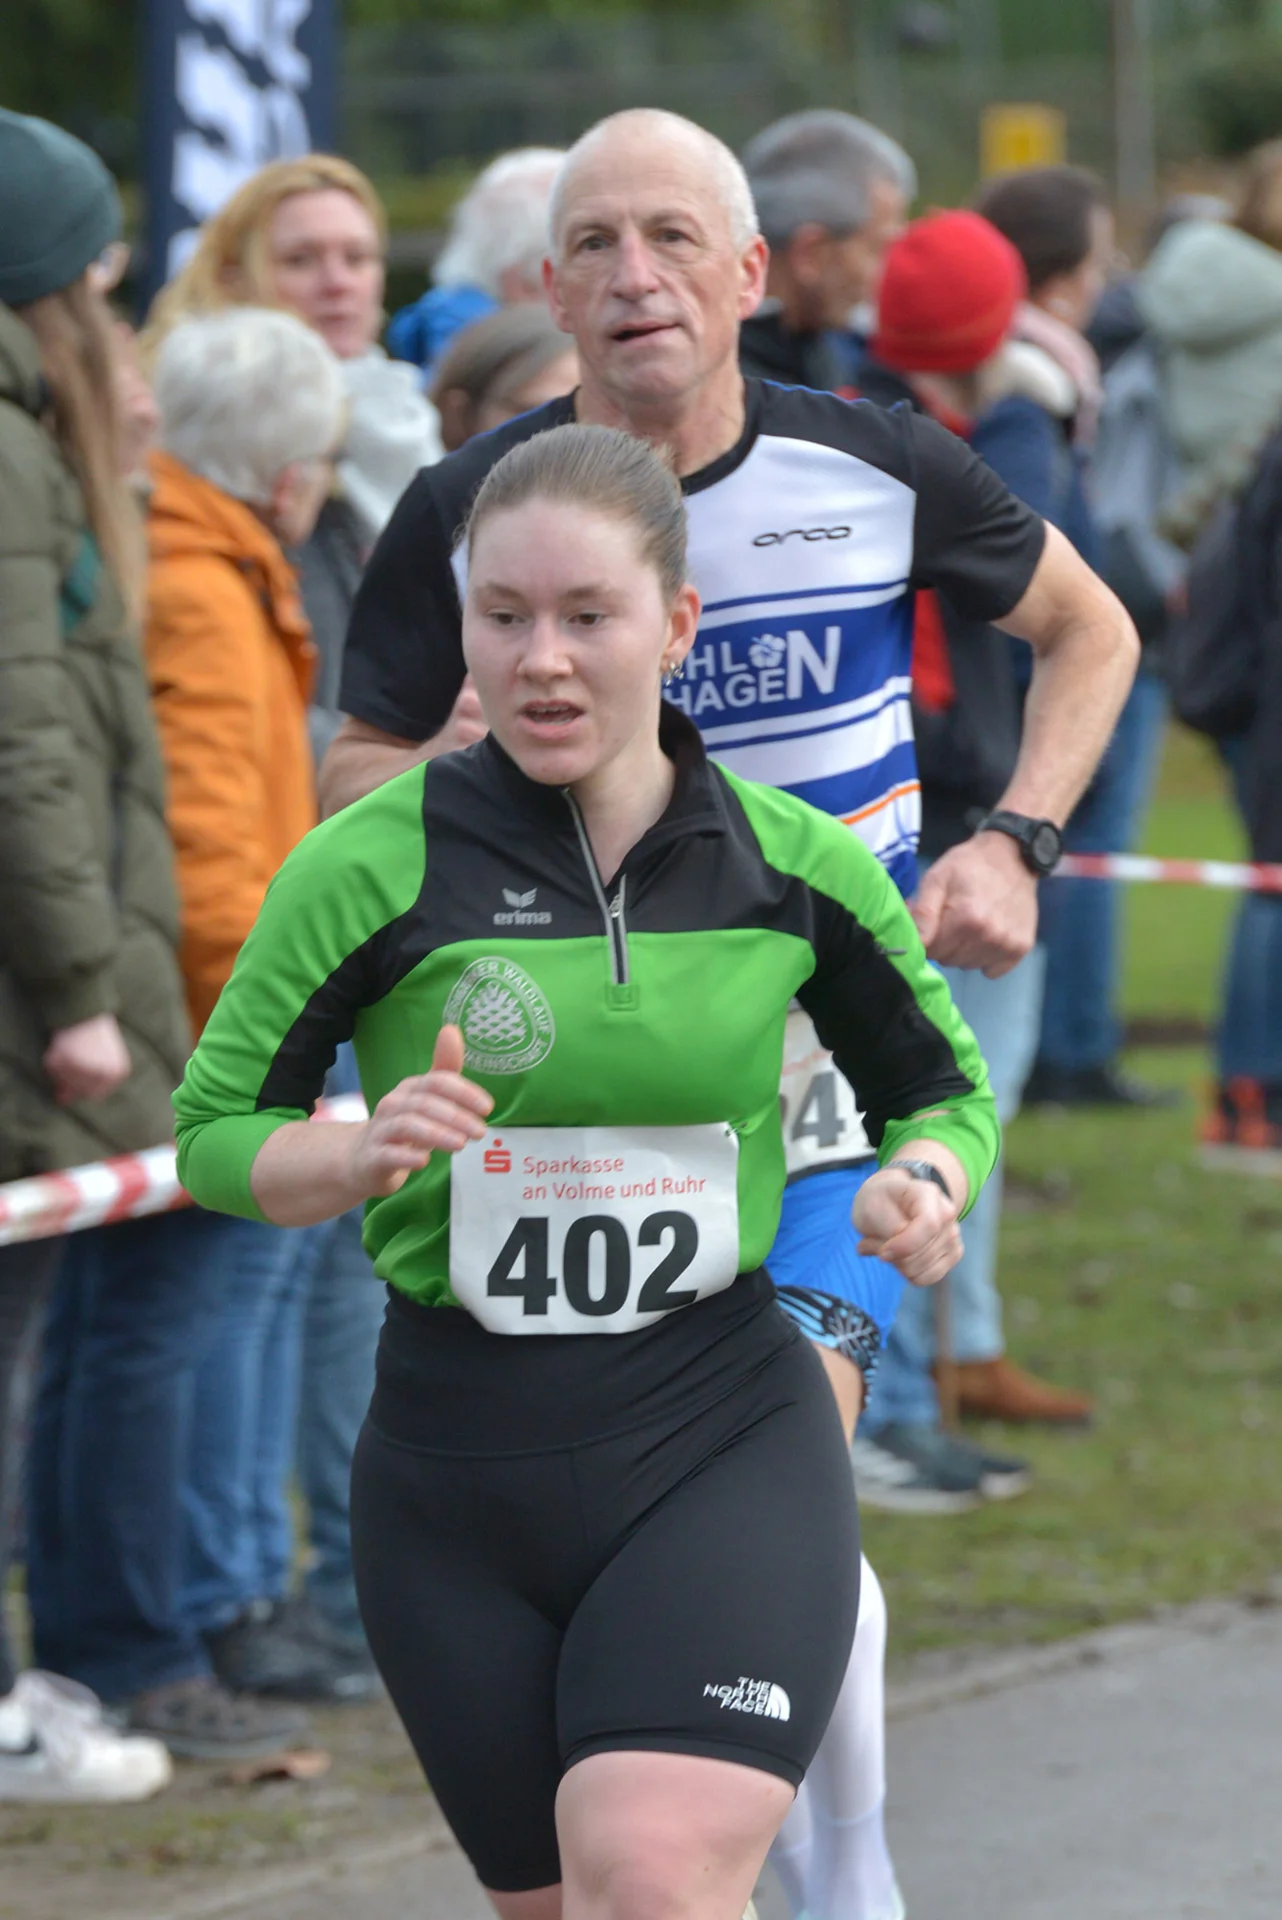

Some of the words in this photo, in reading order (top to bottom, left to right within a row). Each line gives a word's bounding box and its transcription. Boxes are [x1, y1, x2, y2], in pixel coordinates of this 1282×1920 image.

[493, 910, 552, 925] erima
[523, 1156, 624, 1176] Sparkasse
[523, 1186, 546, 1200] an
[552, 1181, 615, 1200] Volme
[620, 1178, 656, 1198] und
[661, 1175, 707, 1194] Ruhr
[486, 1210, 700, 1317] 402
[737, 1676, 771, 1695] THE
[719, 1697, 765, 1716] FACE
